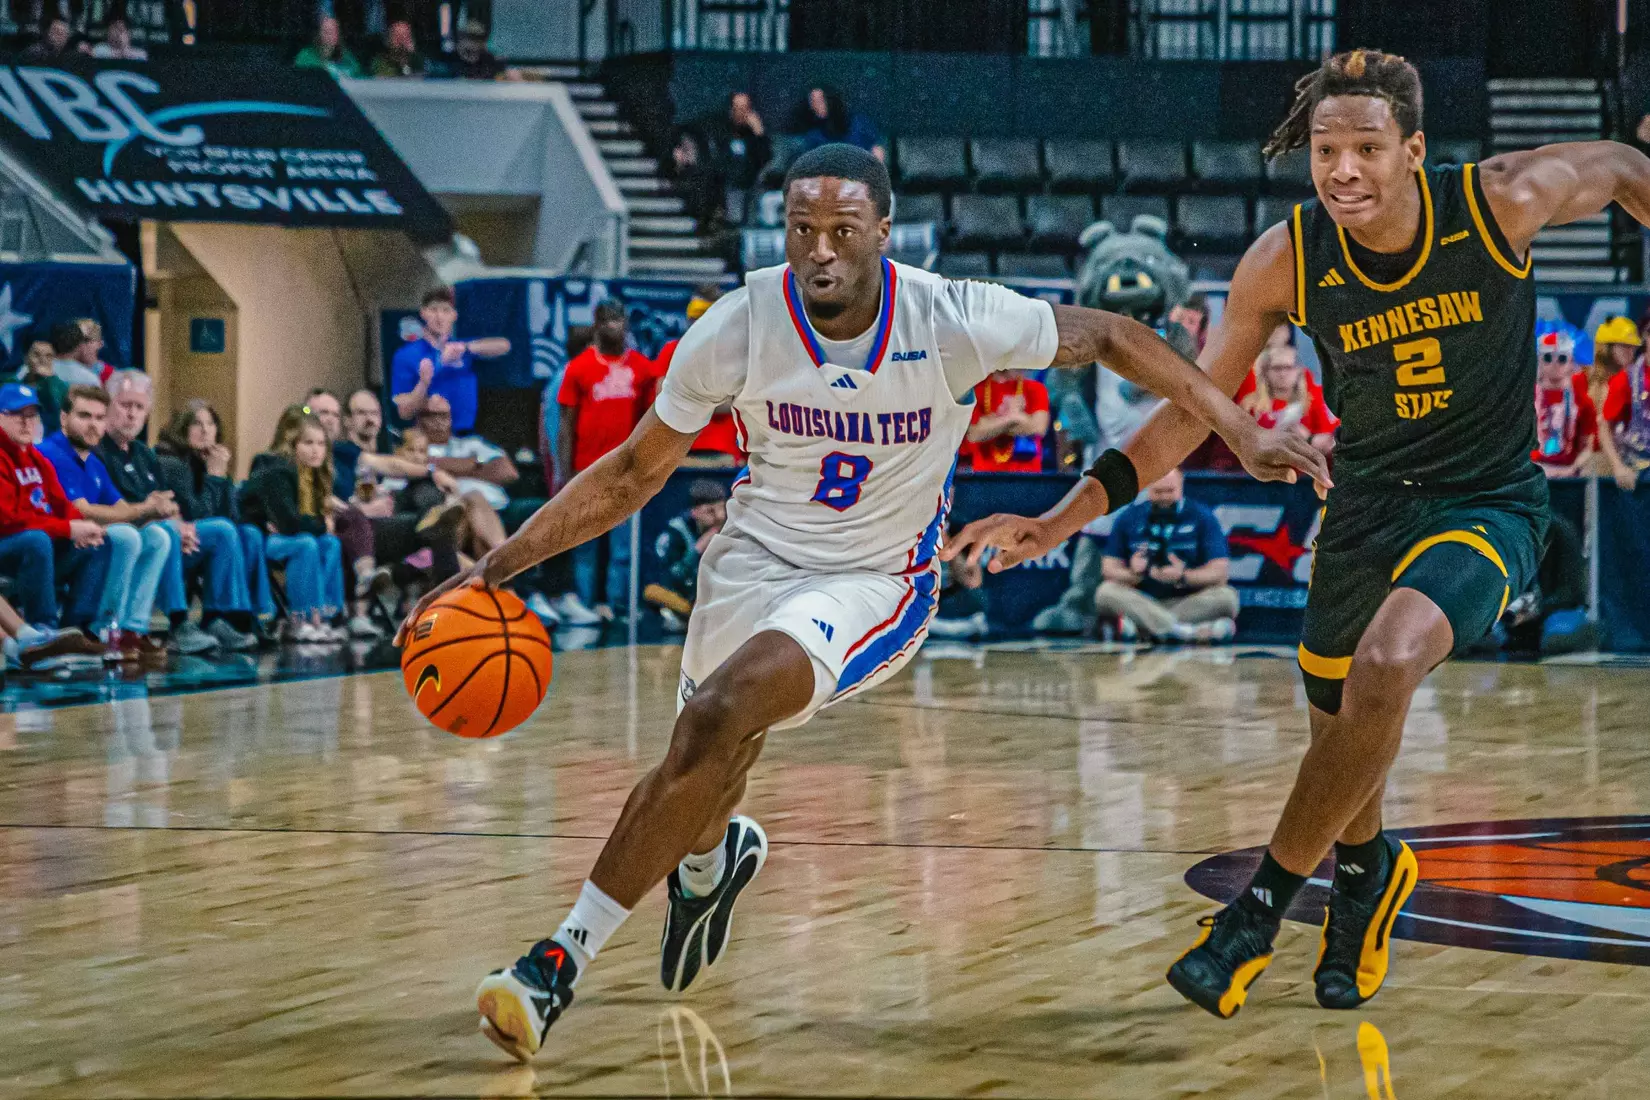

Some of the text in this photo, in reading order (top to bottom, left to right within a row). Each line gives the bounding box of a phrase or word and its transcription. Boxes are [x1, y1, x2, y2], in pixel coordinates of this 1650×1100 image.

[74, 177, 403, 216] HUNTSVILLE
[1338, 291, 1484, 353] KENNESAW
[1392, 336, 1446, 387] 2
[766, 400, 932, 445] LOUISIANA TECH
[809, 450, 874, 513] 8
